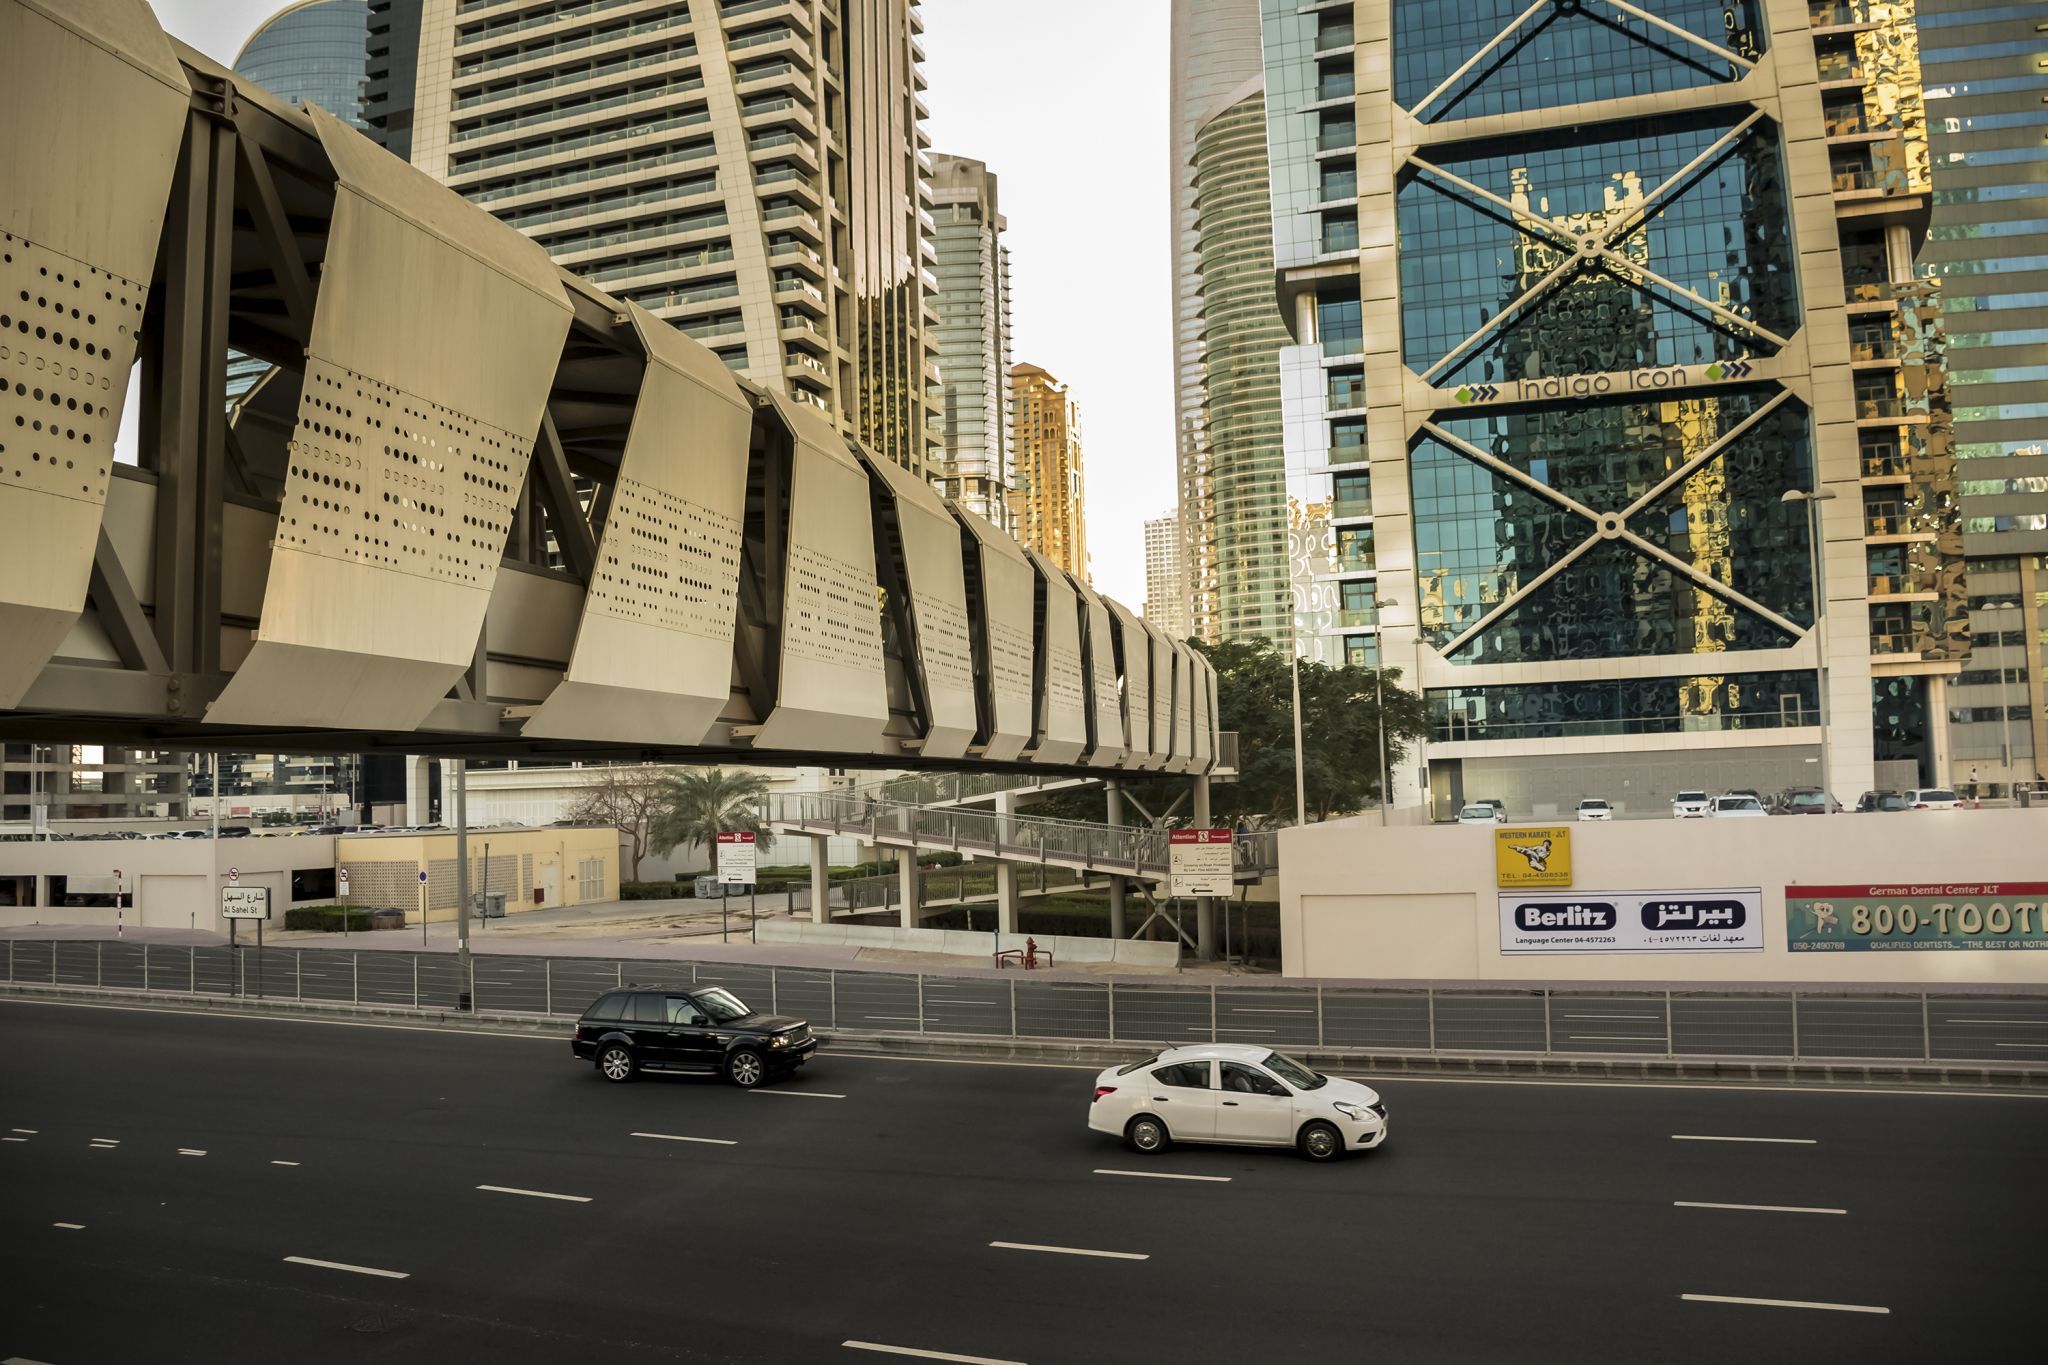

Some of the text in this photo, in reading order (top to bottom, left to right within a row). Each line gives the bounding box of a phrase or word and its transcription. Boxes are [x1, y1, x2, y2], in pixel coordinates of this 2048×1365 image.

[1517, 368, 1687, 400] Indigo Icon
[1499, 831, 1527, 839] WESTERN
[1555, 830, 1566, 838] JLT
[1869, 885, 1999, 896] German Dental Center JLT
[223, 892, 265, 903] شارع السهل
[224, 906, 231, 914] Al
[231, 906, 249, 914] Sahel
[1525, 905, 1607, 926] Berlitz
[1656, 904, 1733, 927] بيرلتز
[1852, 902, 2048, 935] 800-TOOT
[1515, 937, 1549, 945] Language
[1699, 933, 1721, 942] لغات
[1723, 935, 1745, 944] معهد
[1870, 941, 1911, 949] QUALIFIED
[1985, 940, 2006, 949] BEST
[2008, 940, 2020, 949] OR
